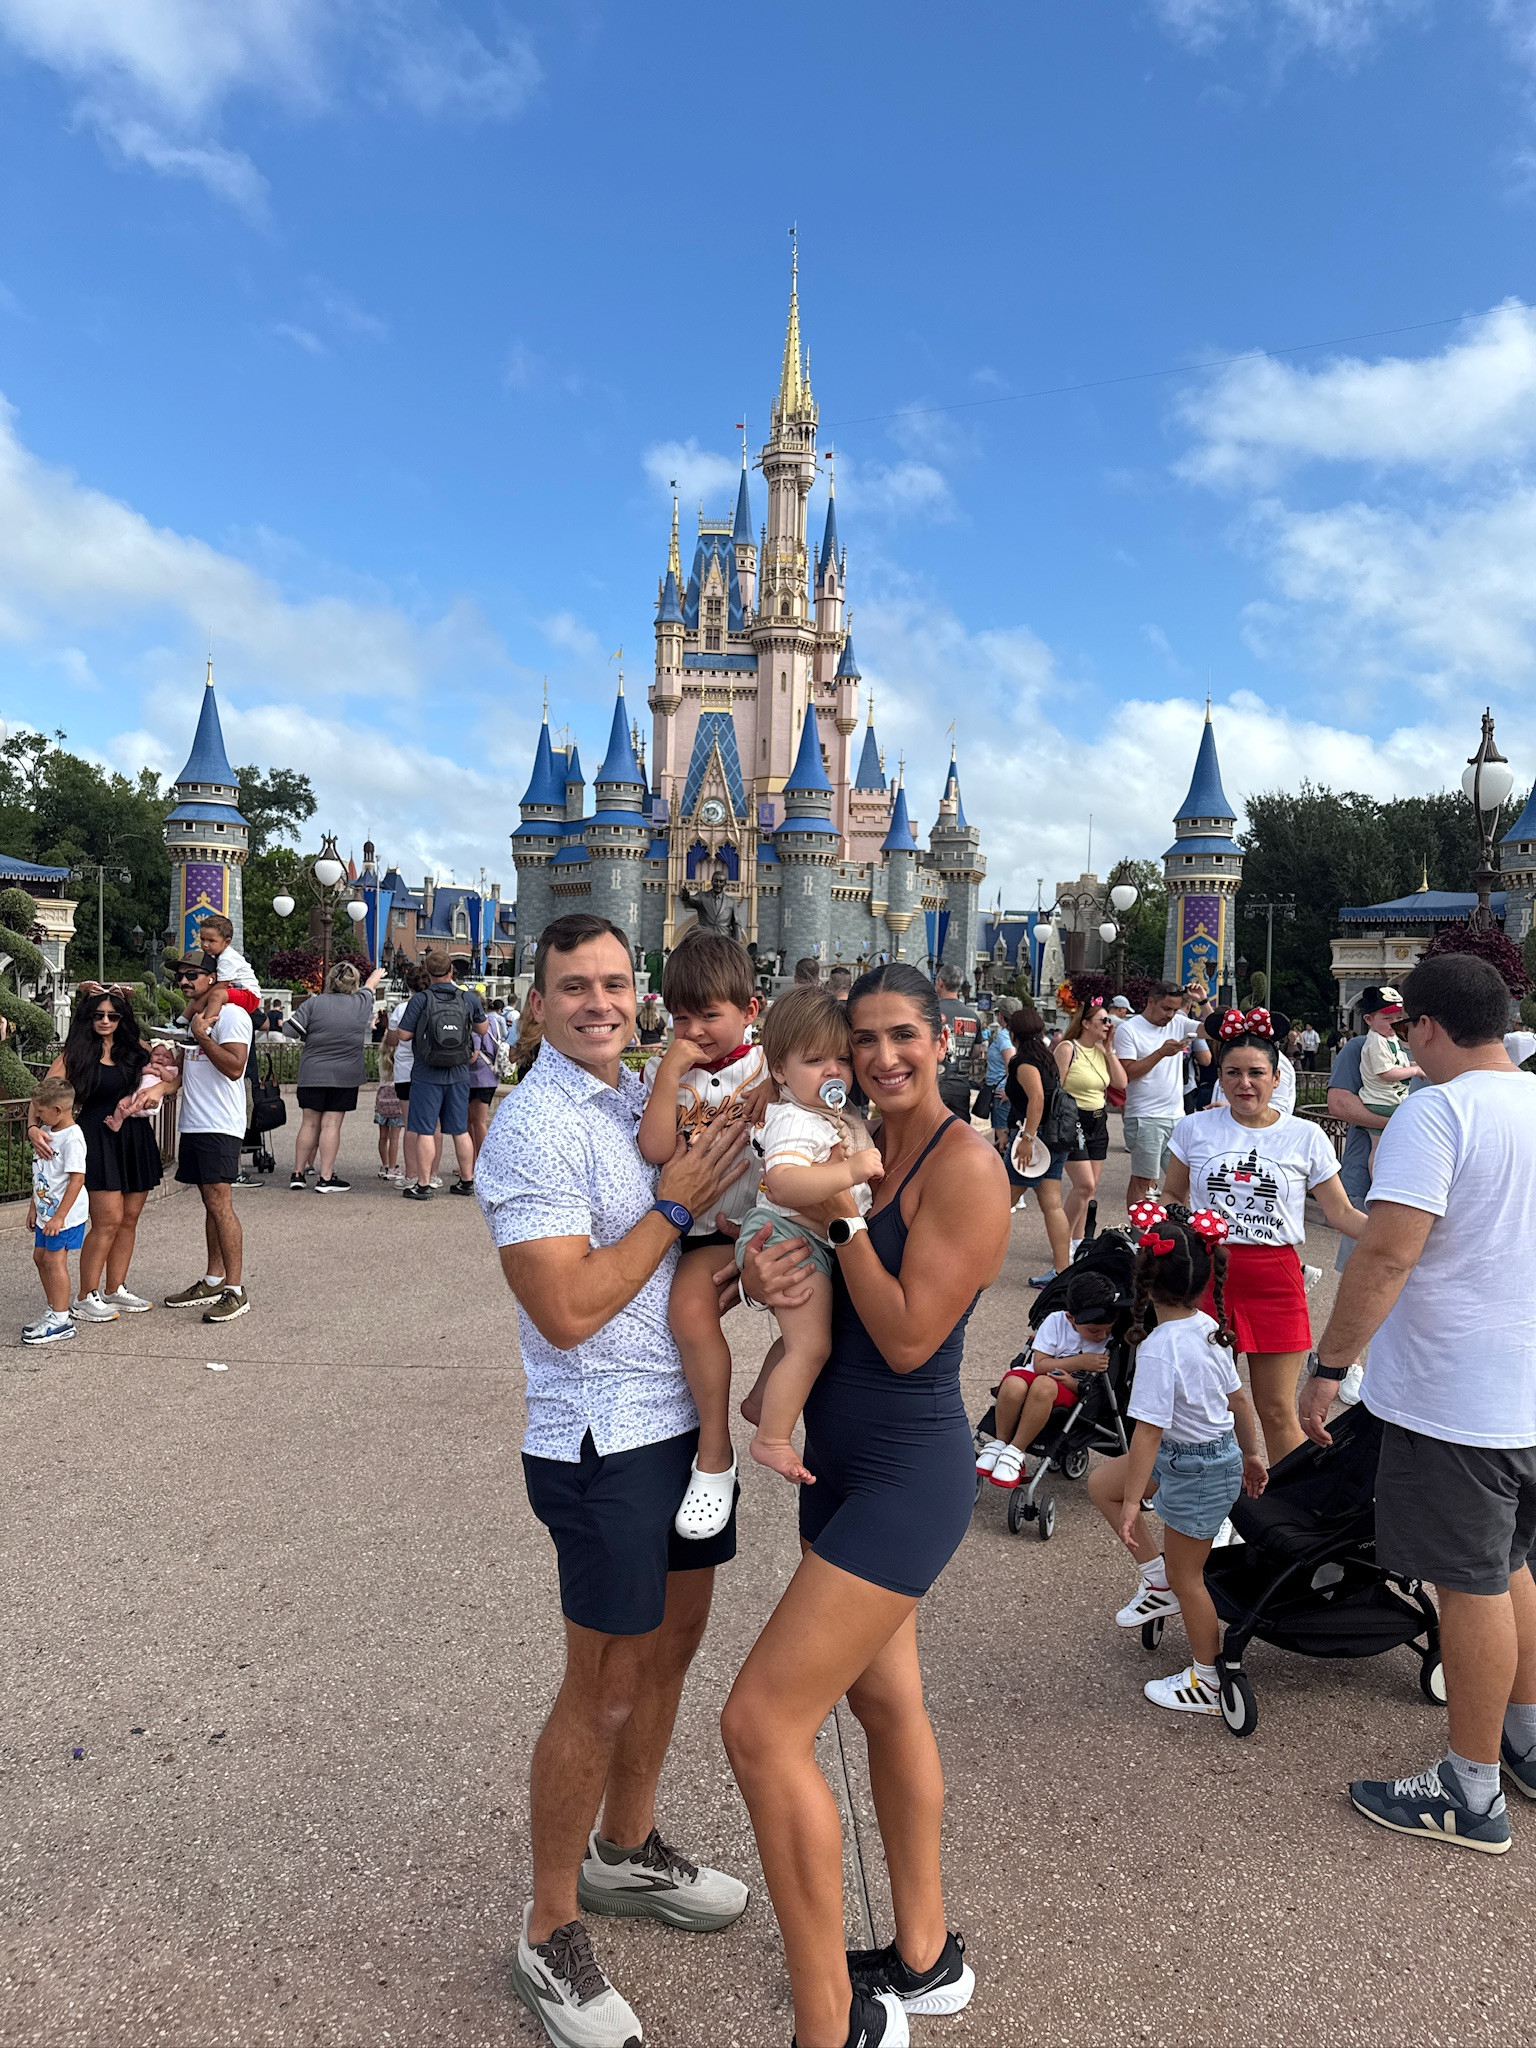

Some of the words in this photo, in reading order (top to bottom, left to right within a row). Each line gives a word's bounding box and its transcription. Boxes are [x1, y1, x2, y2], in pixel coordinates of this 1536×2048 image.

[1209, 1193, 1275, 1213] 2025
[1236, 1212, 1284, 1230] FAMILY
[1228, 1224, 1273, 1240] CATION
